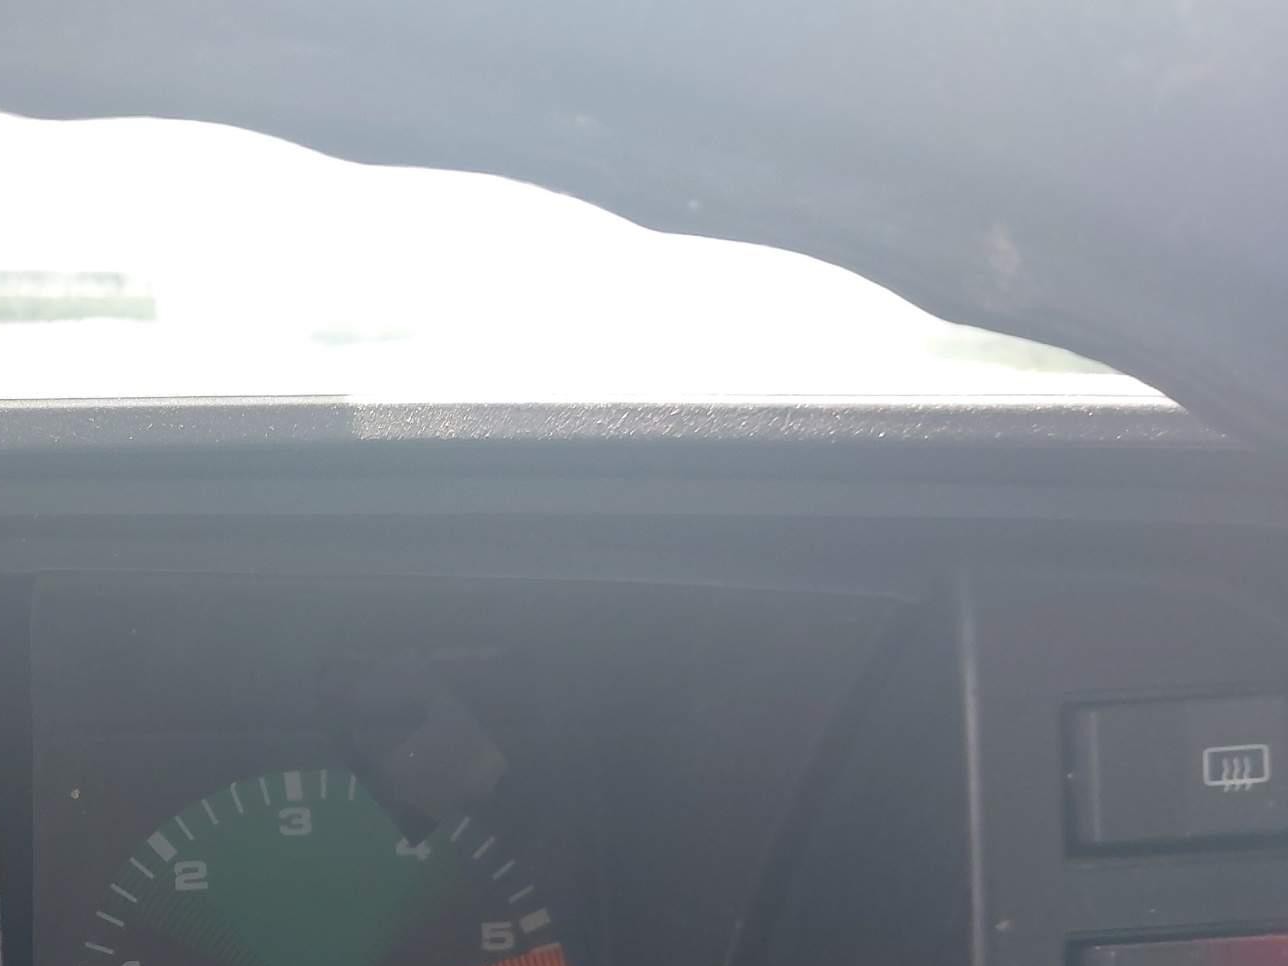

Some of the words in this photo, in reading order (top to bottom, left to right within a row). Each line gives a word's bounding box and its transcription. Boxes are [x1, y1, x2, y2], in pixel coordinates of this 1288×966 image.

[279, 807, 312, 836] 3
[174, 860, 209, 891] 2
[481, 921, 515, 950] 5
